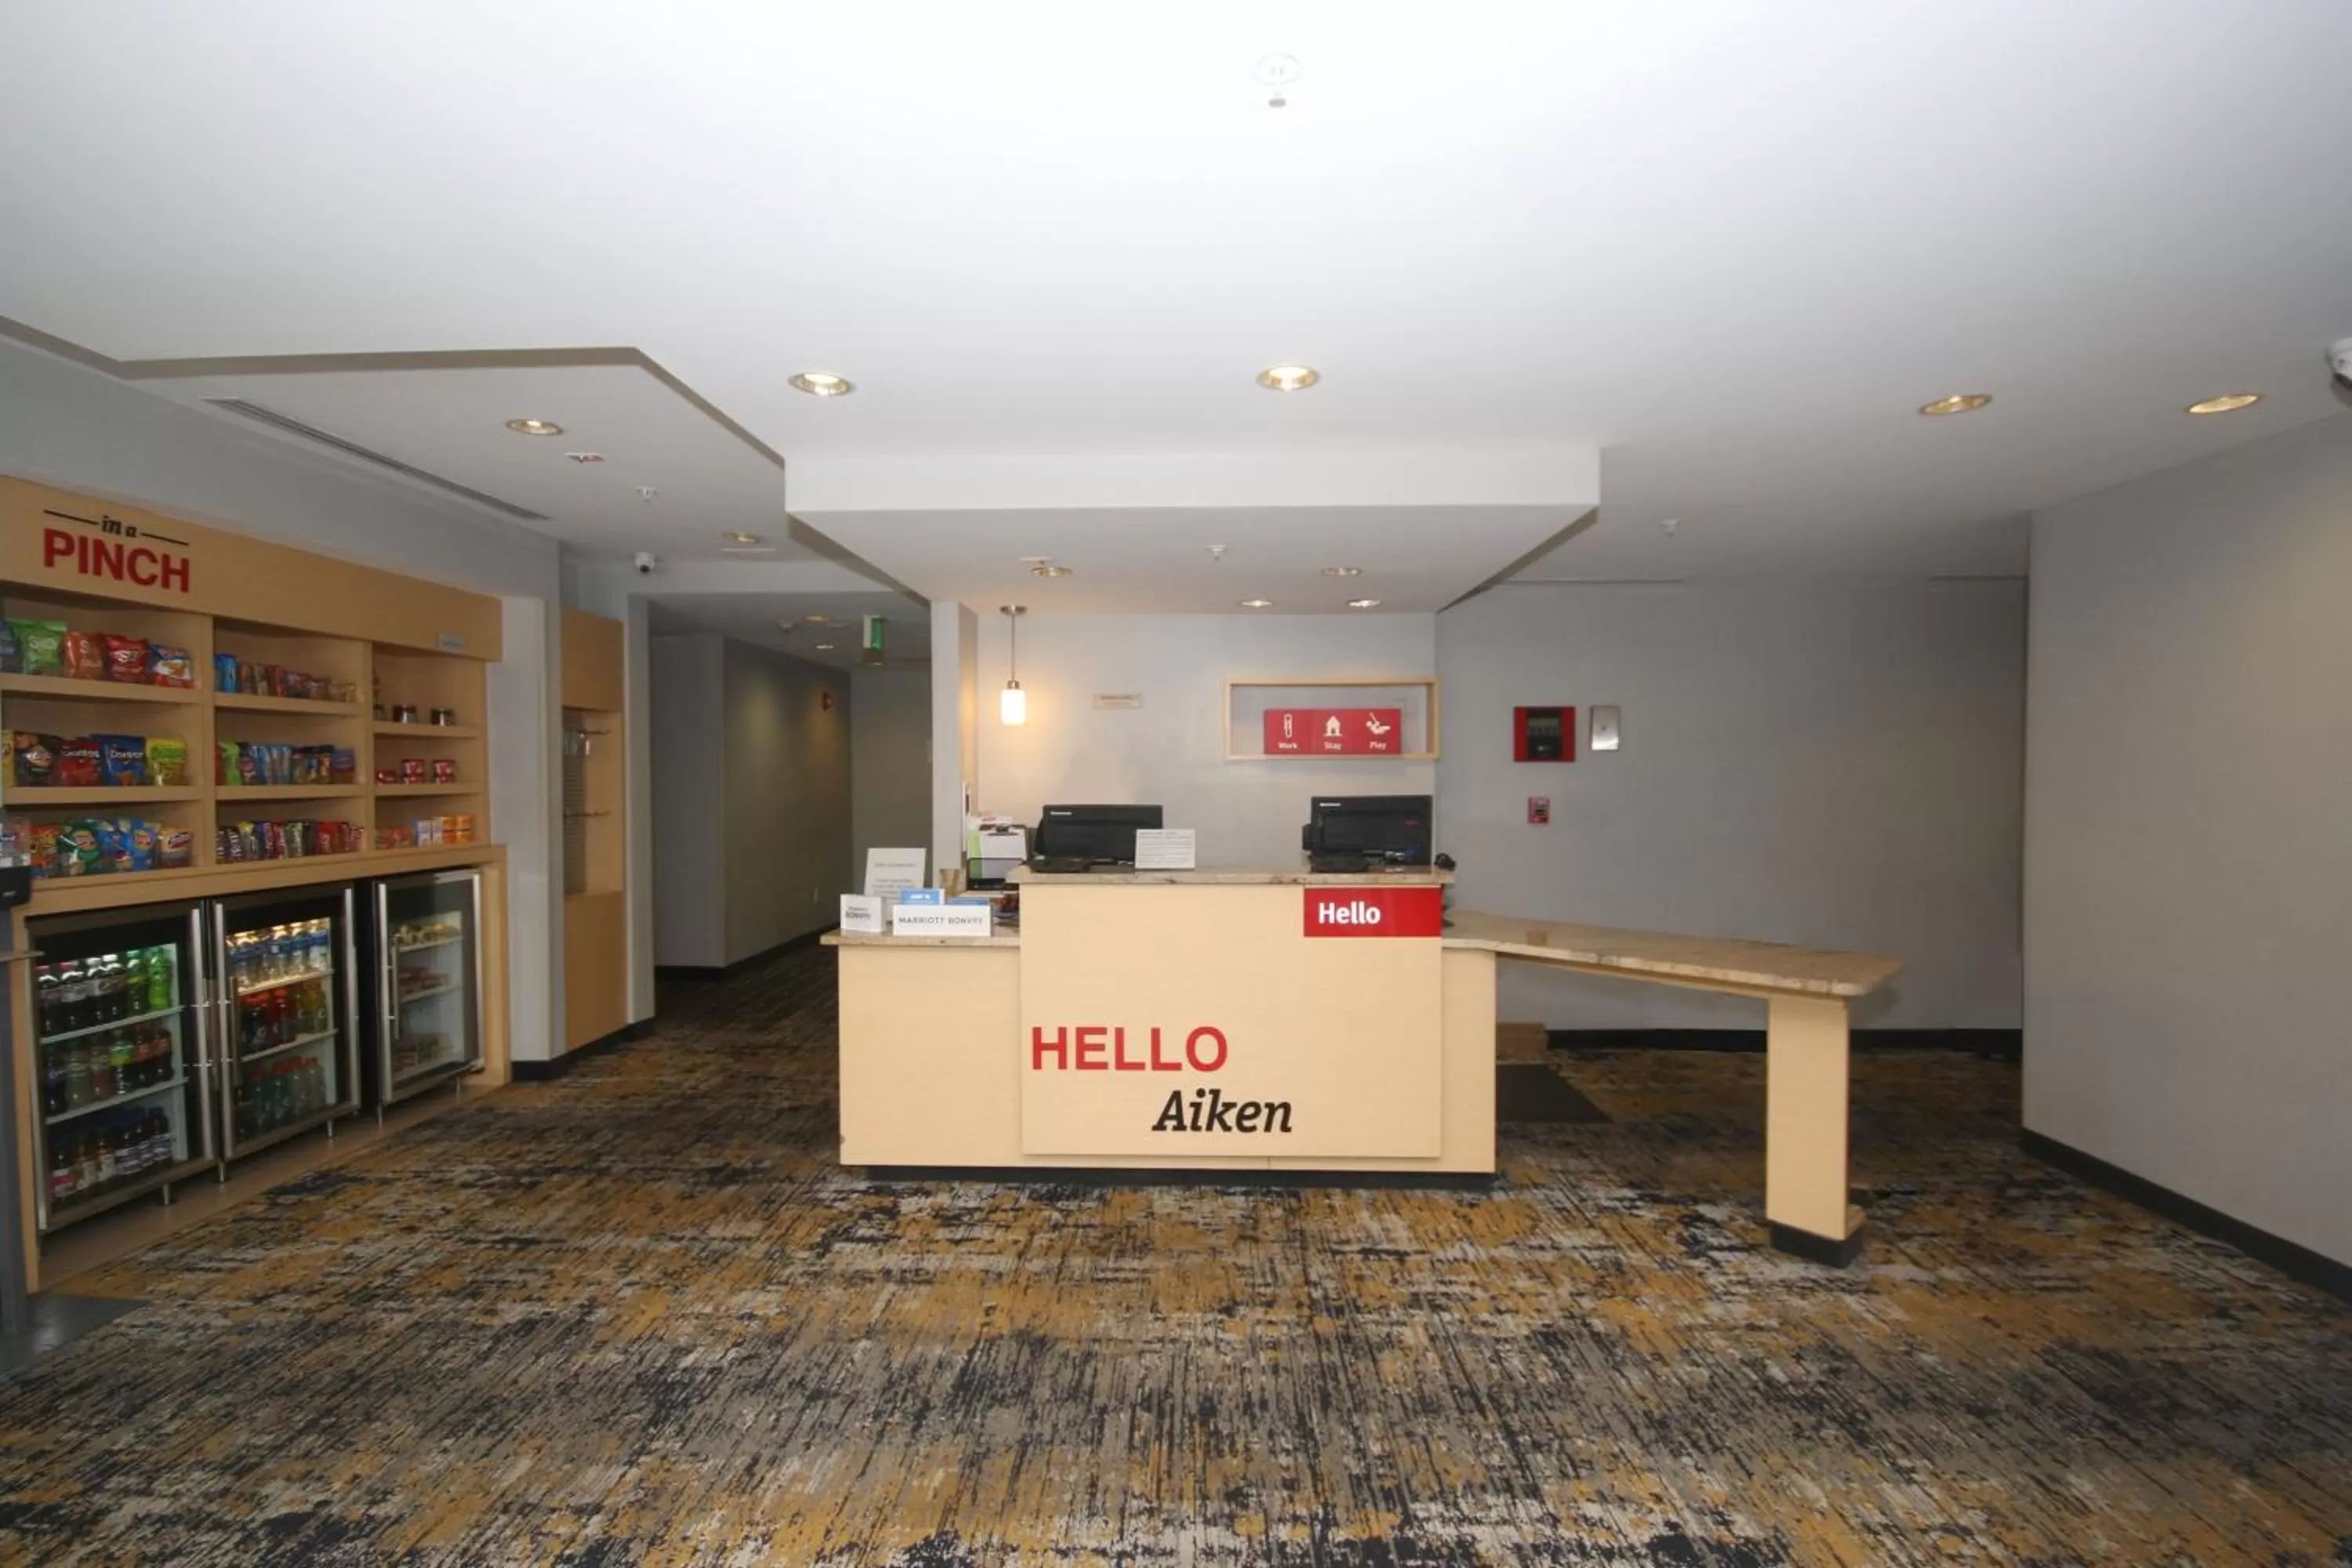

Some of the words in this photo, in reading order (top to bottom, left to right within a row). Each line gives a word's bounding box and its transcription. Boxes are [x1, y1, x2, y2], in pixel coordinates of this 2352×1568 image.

[101, 514, 122, 535] in
[125, 526, 137, 538] a
[43, 527, 190, 593] PINCH
[1278, 741, 1298, 750] Work
[1323, 741, 1342, 750] Stay
[1369, 741, 1387, 750] Play
[898, 916, 945, 924] MARRIOTT
[1319, 902, 1381, 924] Hello
[1032, 1025, 1228, 1073] HELLO
[1151, 1087, 1293, 1134] Aiken
